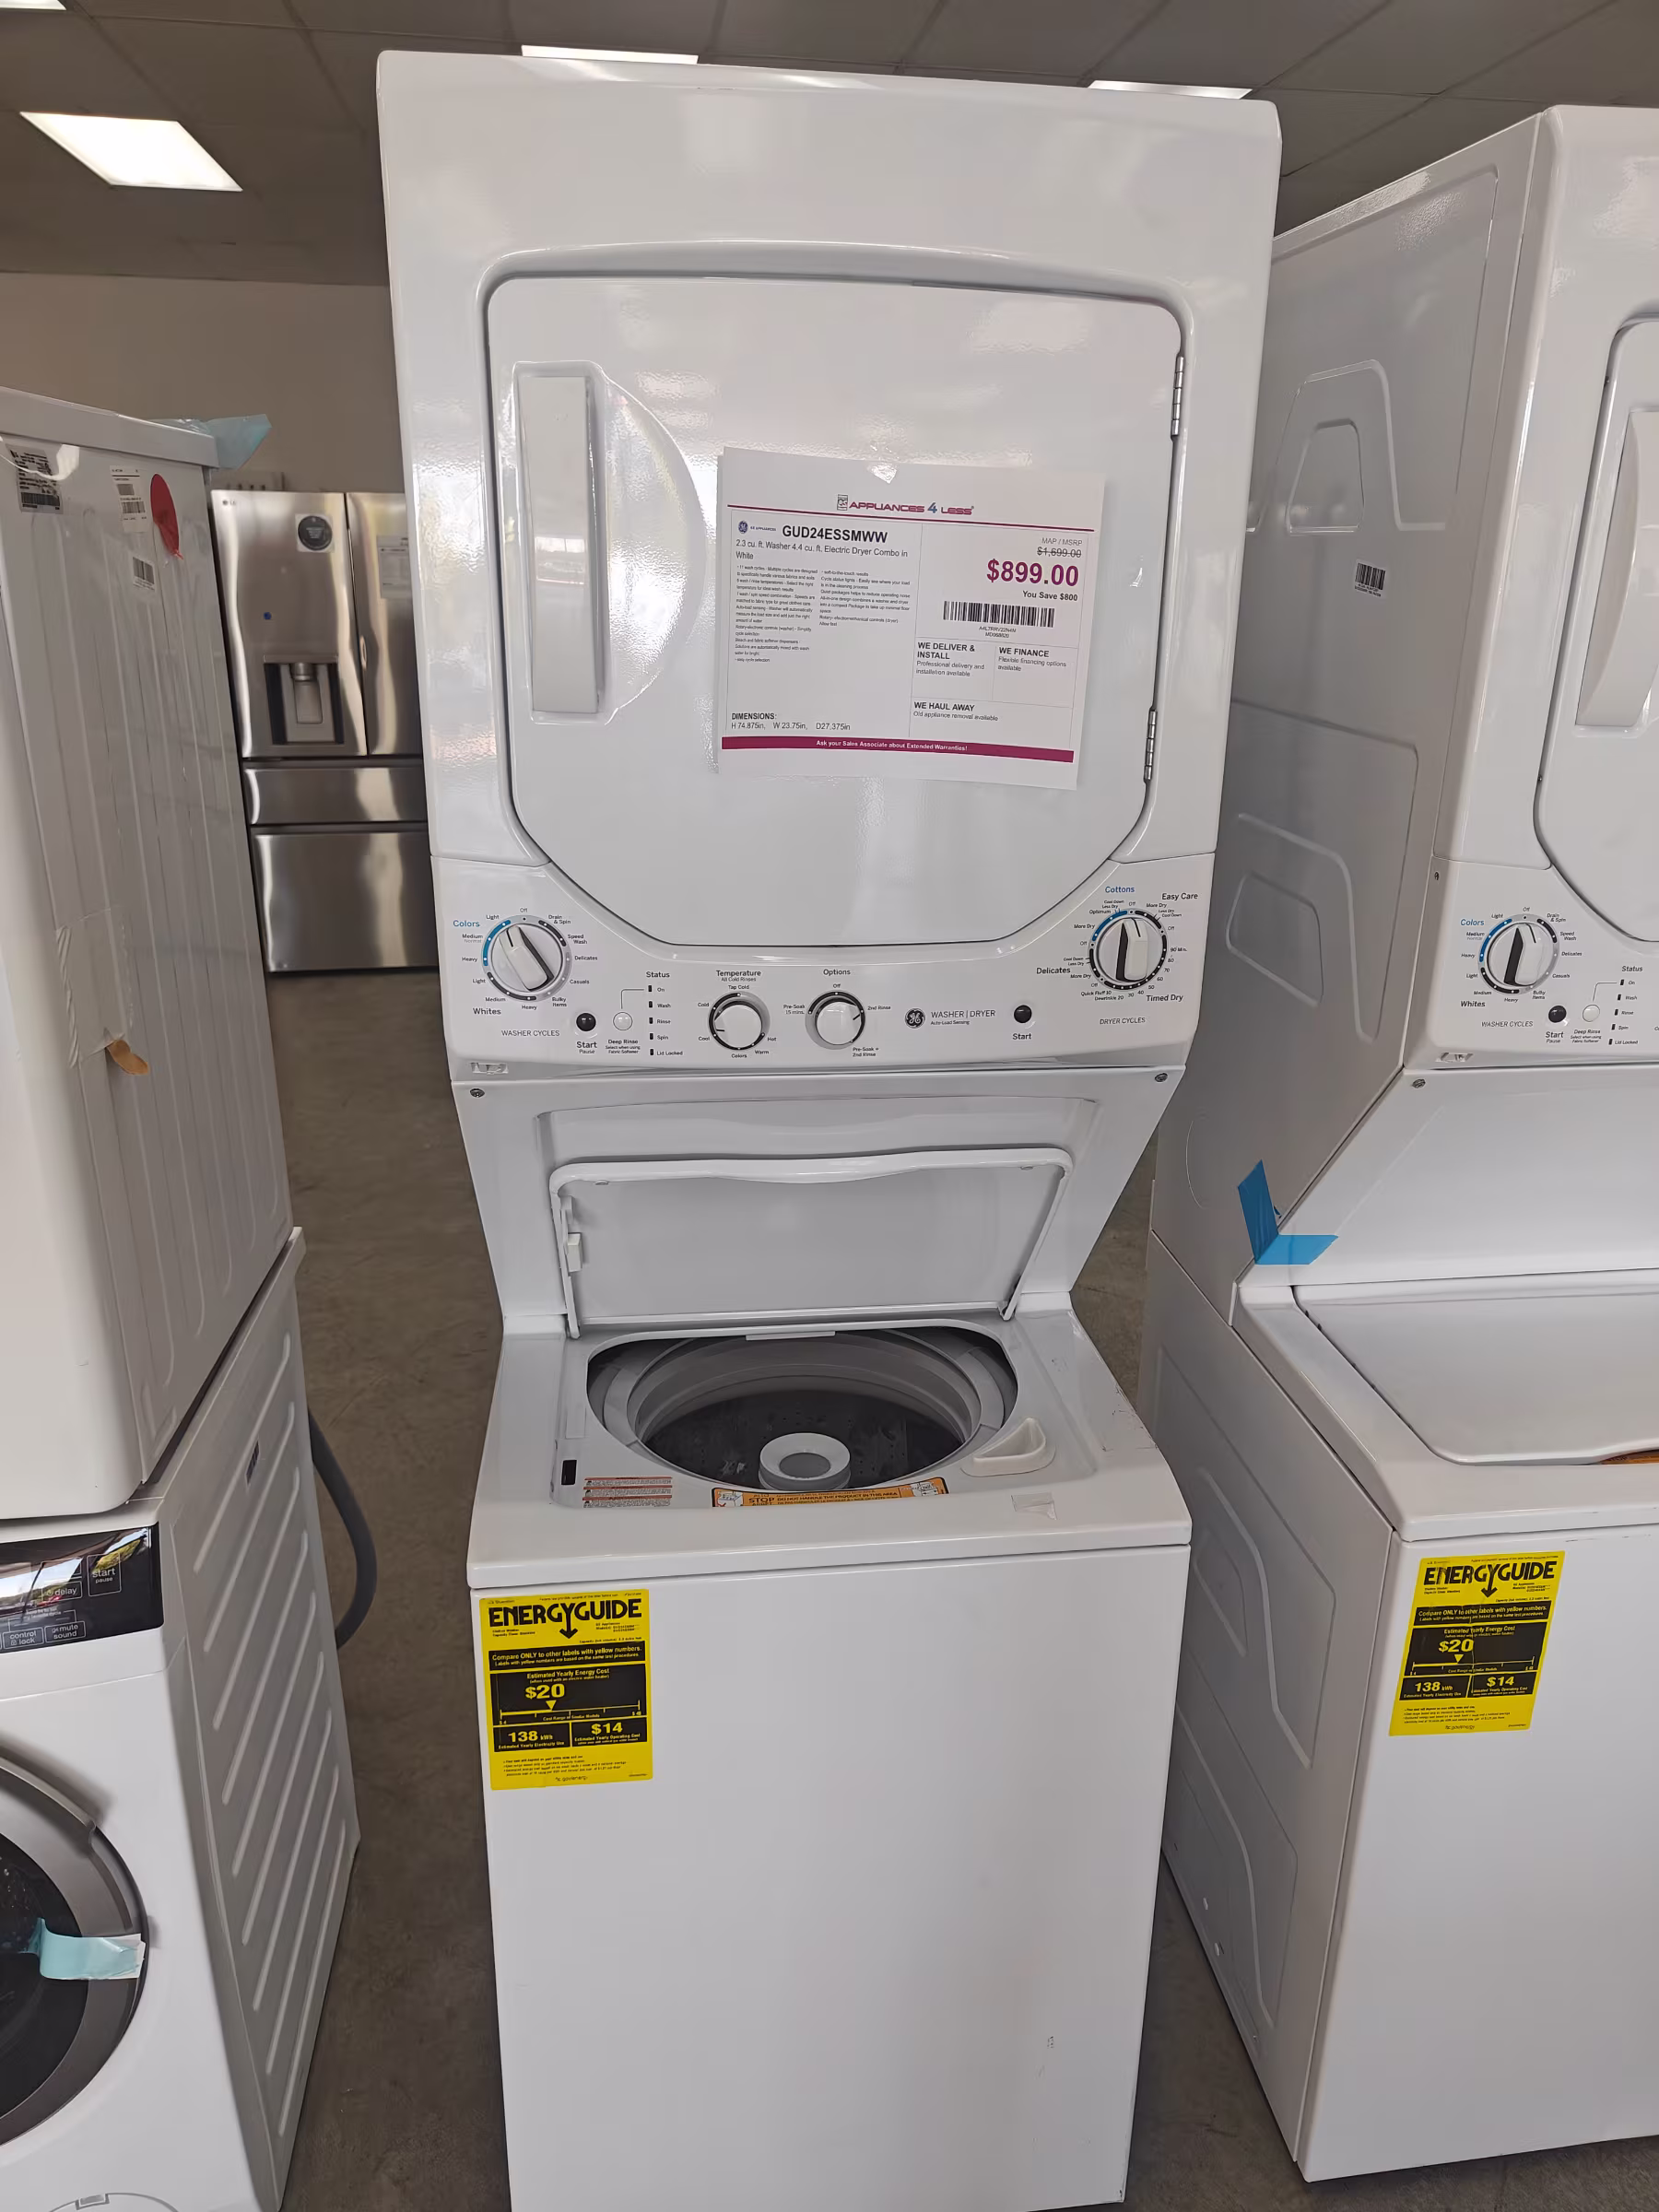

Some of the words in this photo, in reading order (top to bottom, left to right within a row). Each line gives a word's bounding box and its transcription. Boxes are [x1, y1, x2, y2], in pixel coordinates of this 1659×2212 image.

[849, 501, 924, 512] APPLIANCES
[927, 502, 937, 513] 4
[941, 506, 972, 515] LESS
[782, 525, 888, 543] GUD24ESSMWW
[736, 539, 747, 547] 2.3
[765, 541, 791, 550] Washer
[824, 546, 850, 555] Electric
[852, 547, 871, 557] Dryer
[874, 548, 900, 557] Combo
[1037, 547, 1082, 558] $1,699.00
[736, 551, 754, 559] White
[986, 559, 1079, 586] $899.00
[1022, 590, 1037, 599] You
[1039, 591, 1057, 600] Save
[1060, 593, 1078, 601] $800
[933, 643, 968, 652] DELIVER
[1014, 648, 1050, 657] FINANCE
[917, 652, 950, 660] INSTALL
[1020, 658, 1045, 666] financing
[914, 701, 927, 710] WE
[928, 702, 950, 711] HAUL
[731, 712, 777, 721] DIMENSIONS:
[924, 712, 950, 720] appliance
[737, 723, 766, 731] 74.875in,
[782, 723, 808, 731] 23.75in,
[816, 723, 851, 731] D27.375in
[576, 1041, 597, 1049] Start
[92, 1568, 116, 1578] start
[1423, 1560, 1558, 1586] ENERGYGUIDE
[54, 1587, 77, 1596] delay
[488, 1598, 642, 1627] ENERGYGUIDE
[1506, 1606, 1523, 1614] yellow
[10, 1630, 37, 1640] control
[53, 1630, 77, 1640] sound
[19, 1637, 35, 1645] lock
[1438, 1638, 1475, 1652] $20
[492, 1652, 519, 1661] Compare
[594, 1647, 613, 1655] yellow
[526, 1671, 555, 1679] Estimated
[557, 1670, 574, 1678] Yearly
[575, 1669, 595, 1677] Energy
[1414, 1681, 1441, 1692] 138
[1487, 1676, 1514, 1688] $14
[524, 1683, 565, 1700] $20
[591, 1722, 622, 1735] $14
[508, 1730, 538, 1743] 138
